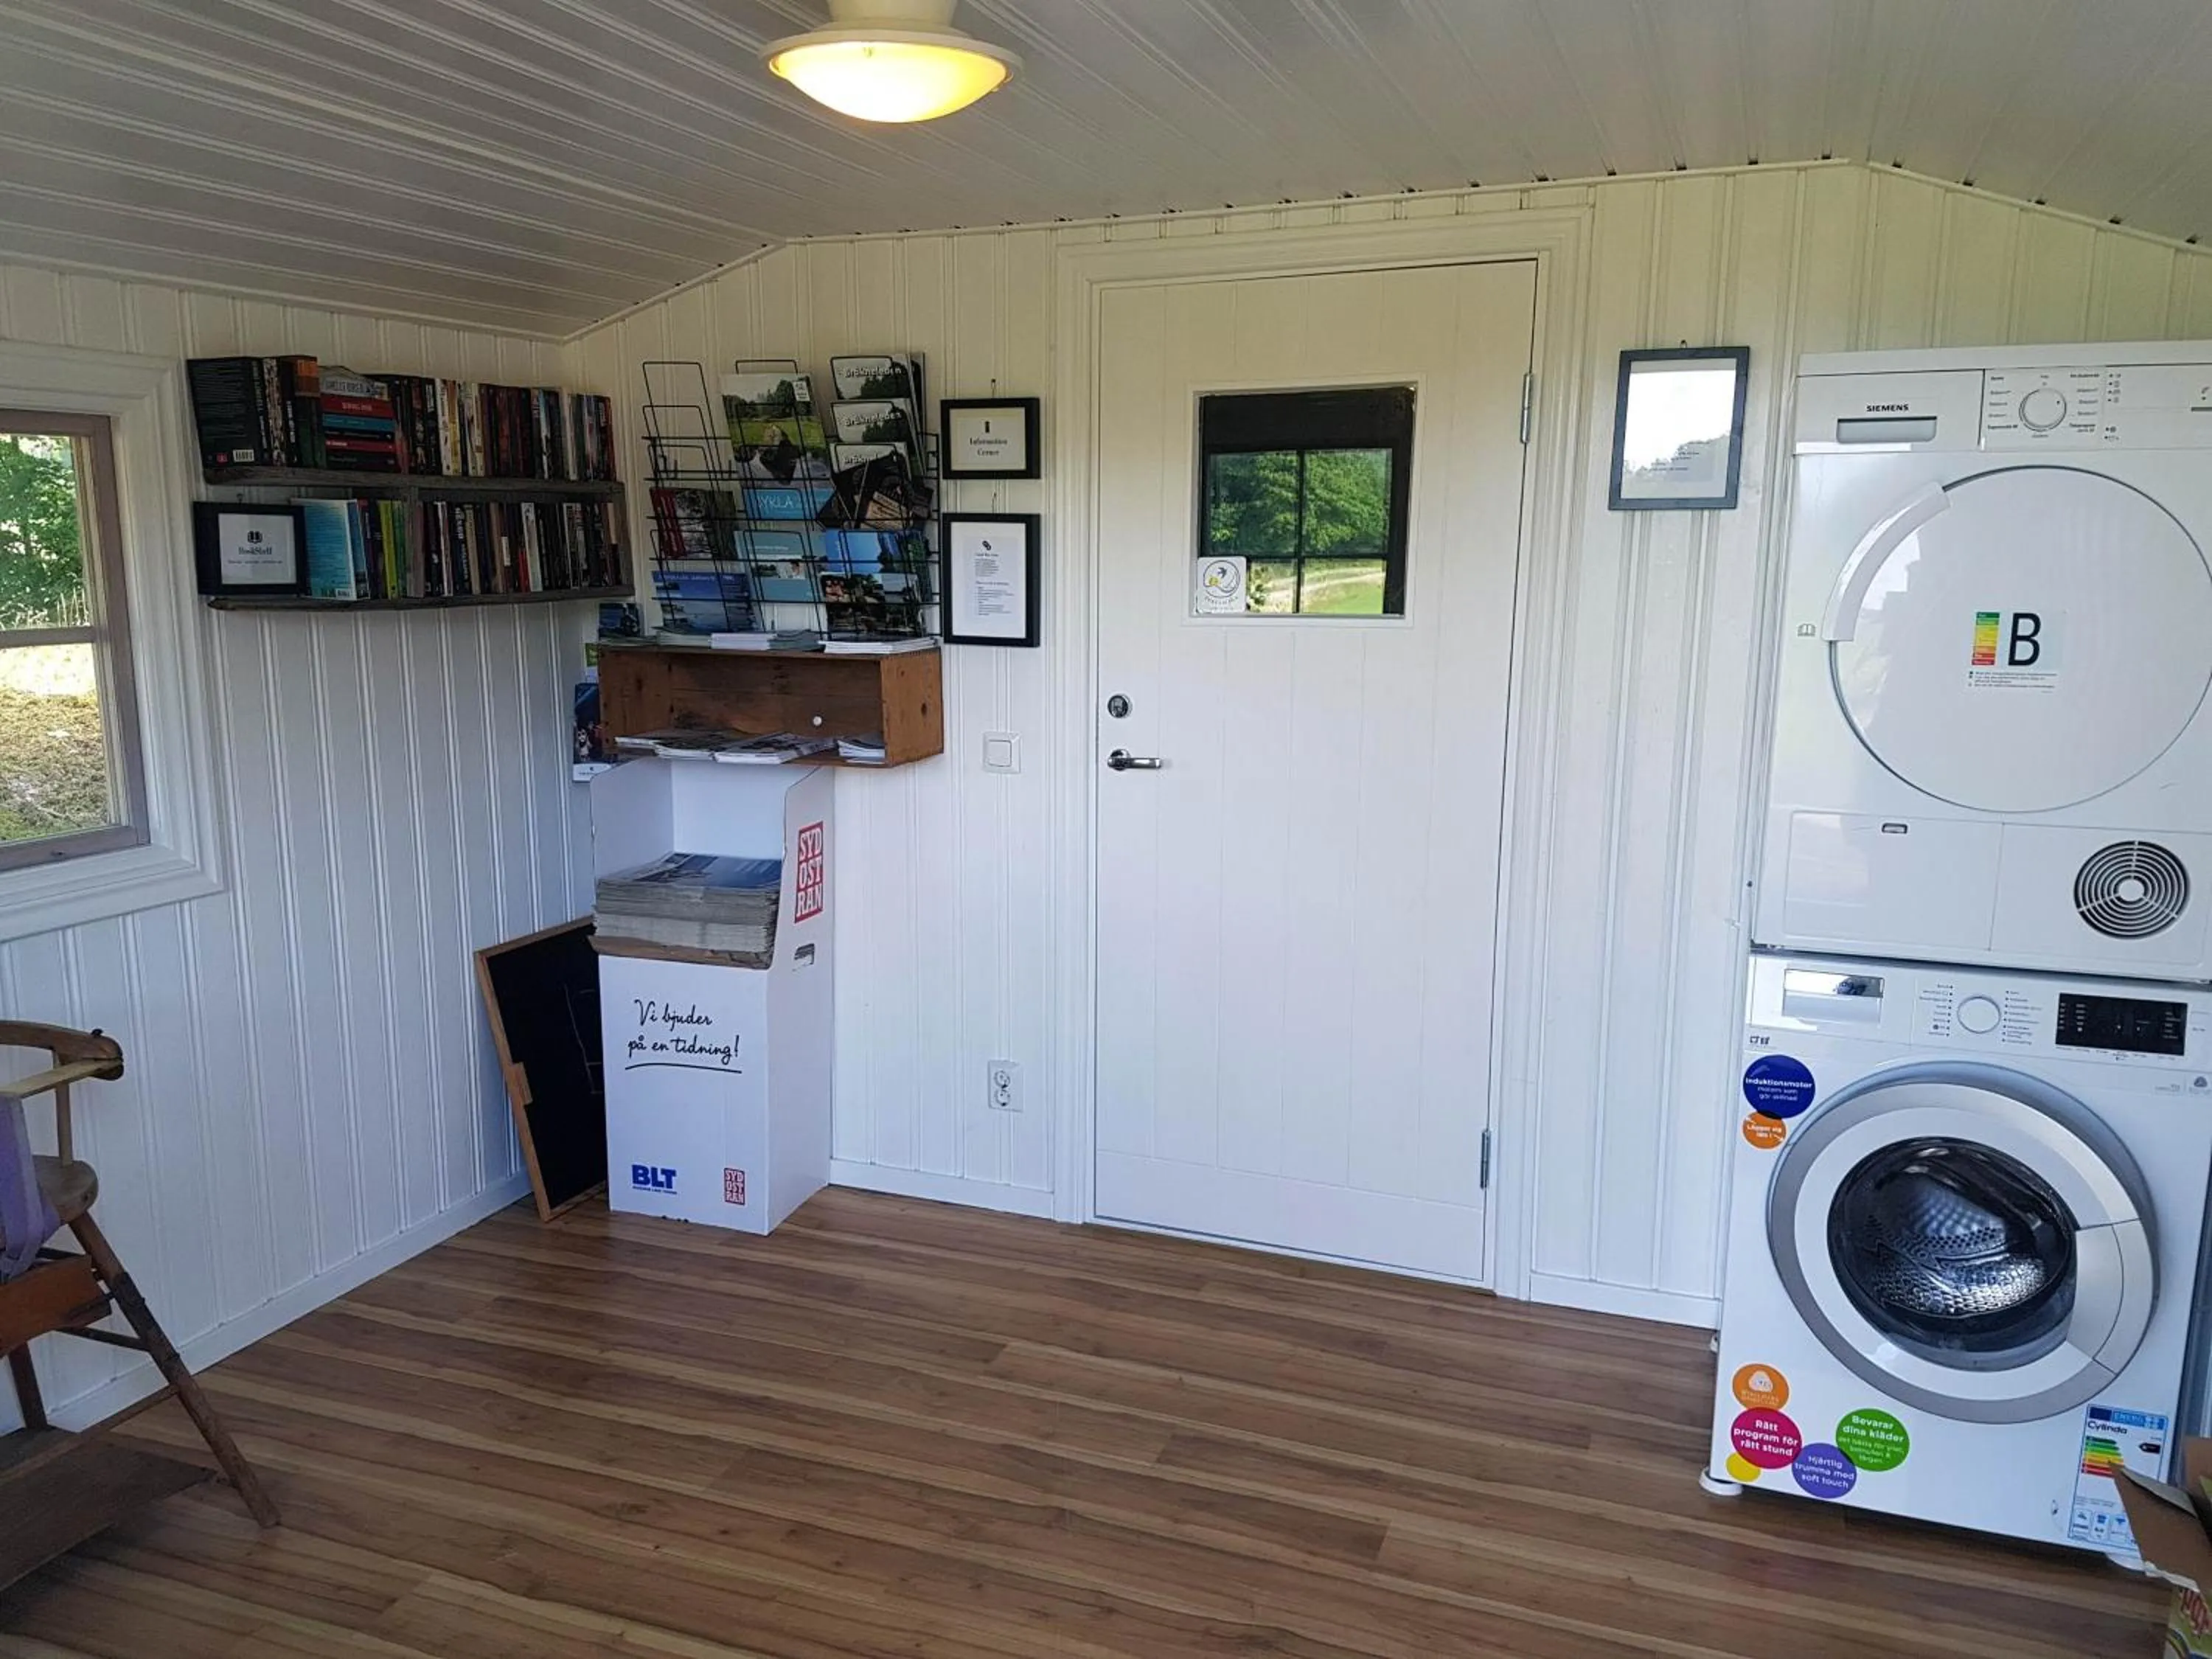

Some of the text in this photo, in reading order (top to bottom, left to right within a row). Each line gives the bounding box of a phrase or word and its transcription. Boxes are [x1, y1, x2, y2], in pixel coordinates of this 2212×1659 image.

[1866, 404, 1909, 412] SIEMENS
[2008, 613, 2041, 666] B
[799, 827, 823, 862] SYD
[797, 883, 822, 916] RAN
[634, 999, 712, 1032] Vi bjuder
[627, 1034, 740, 1065] på en tidning!
[1745, 1077, 1812, 1088] Induktionsmotor
[632, 1164, 677, 1189] BLT
[725, 1169, 743, 1181] SYD
[1756, 1419, 1778, 1432] Rätt
[1843, 1425, 1904, 1442] dina kläder
[2087, 1420, 2127, 1434] Cylinda
[1733, 1427, 1798, 1446] program för
[1741, 1439, 1792, 1456] rätt stund
[1795, 1462, 1854, 1481] trumma med
[1801, 1474, 1848, 1489] soft touch
